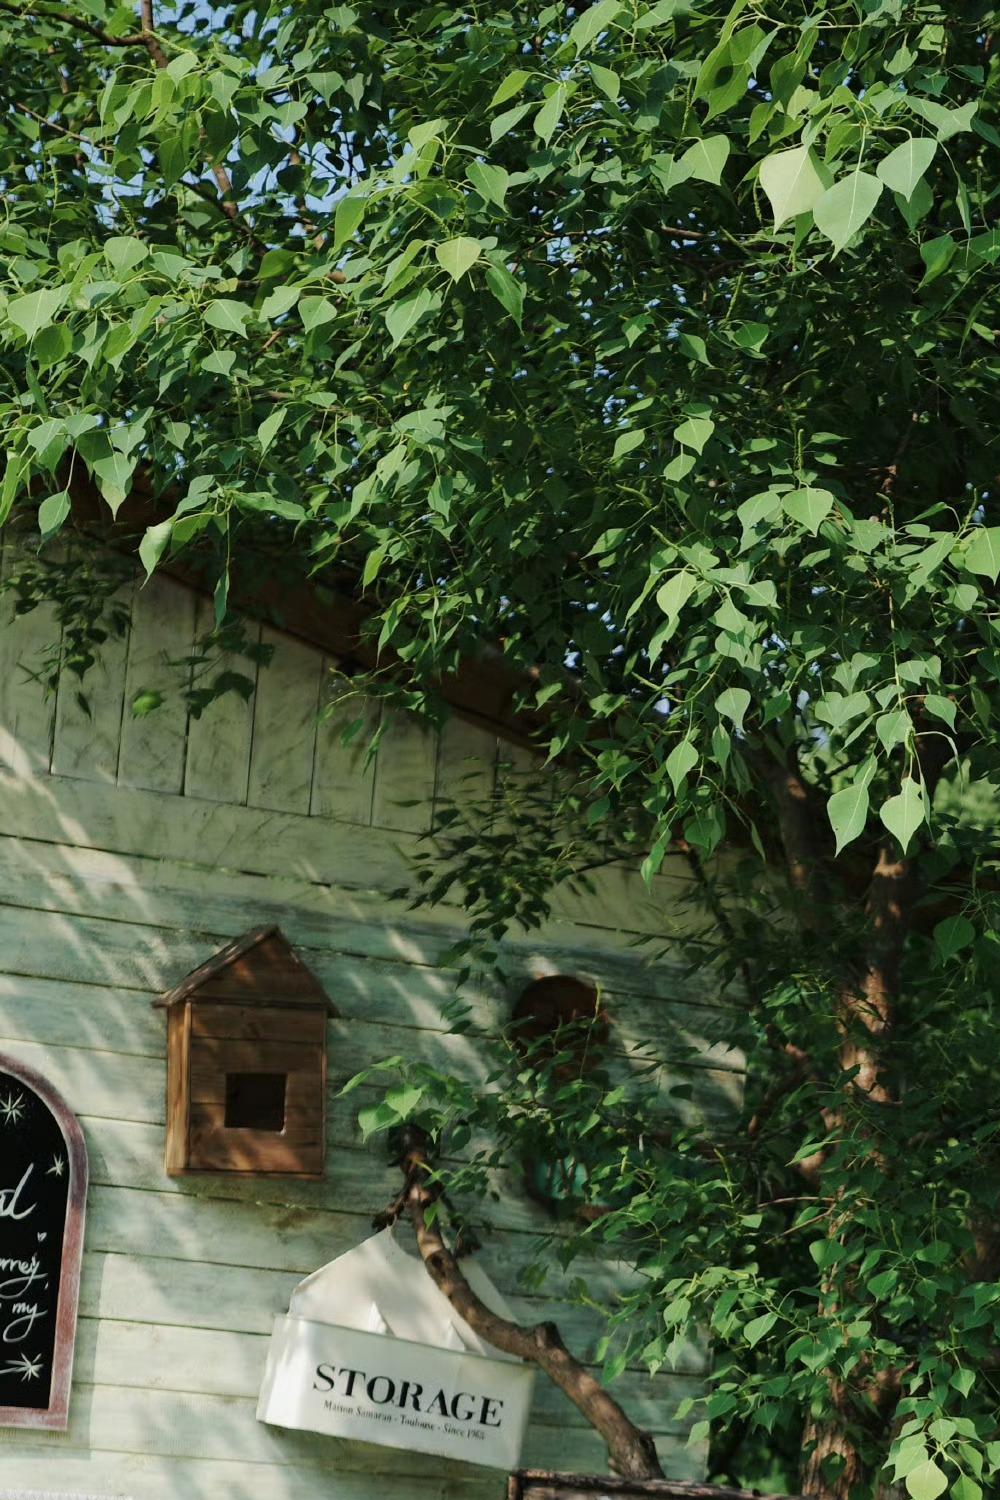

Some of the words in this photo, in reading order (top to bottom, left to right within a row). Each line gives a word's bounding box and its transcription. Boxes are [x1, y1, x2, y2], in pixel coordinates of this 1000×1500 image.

[3, 1302, 48, 1343] my
[312, 1362, 504, 1428] STORAGE
[323, 1399, 354, 1415] Maison
[400, 1414, 434, 1432] Toulouse
[443, 1423, 464, 1438] Since
